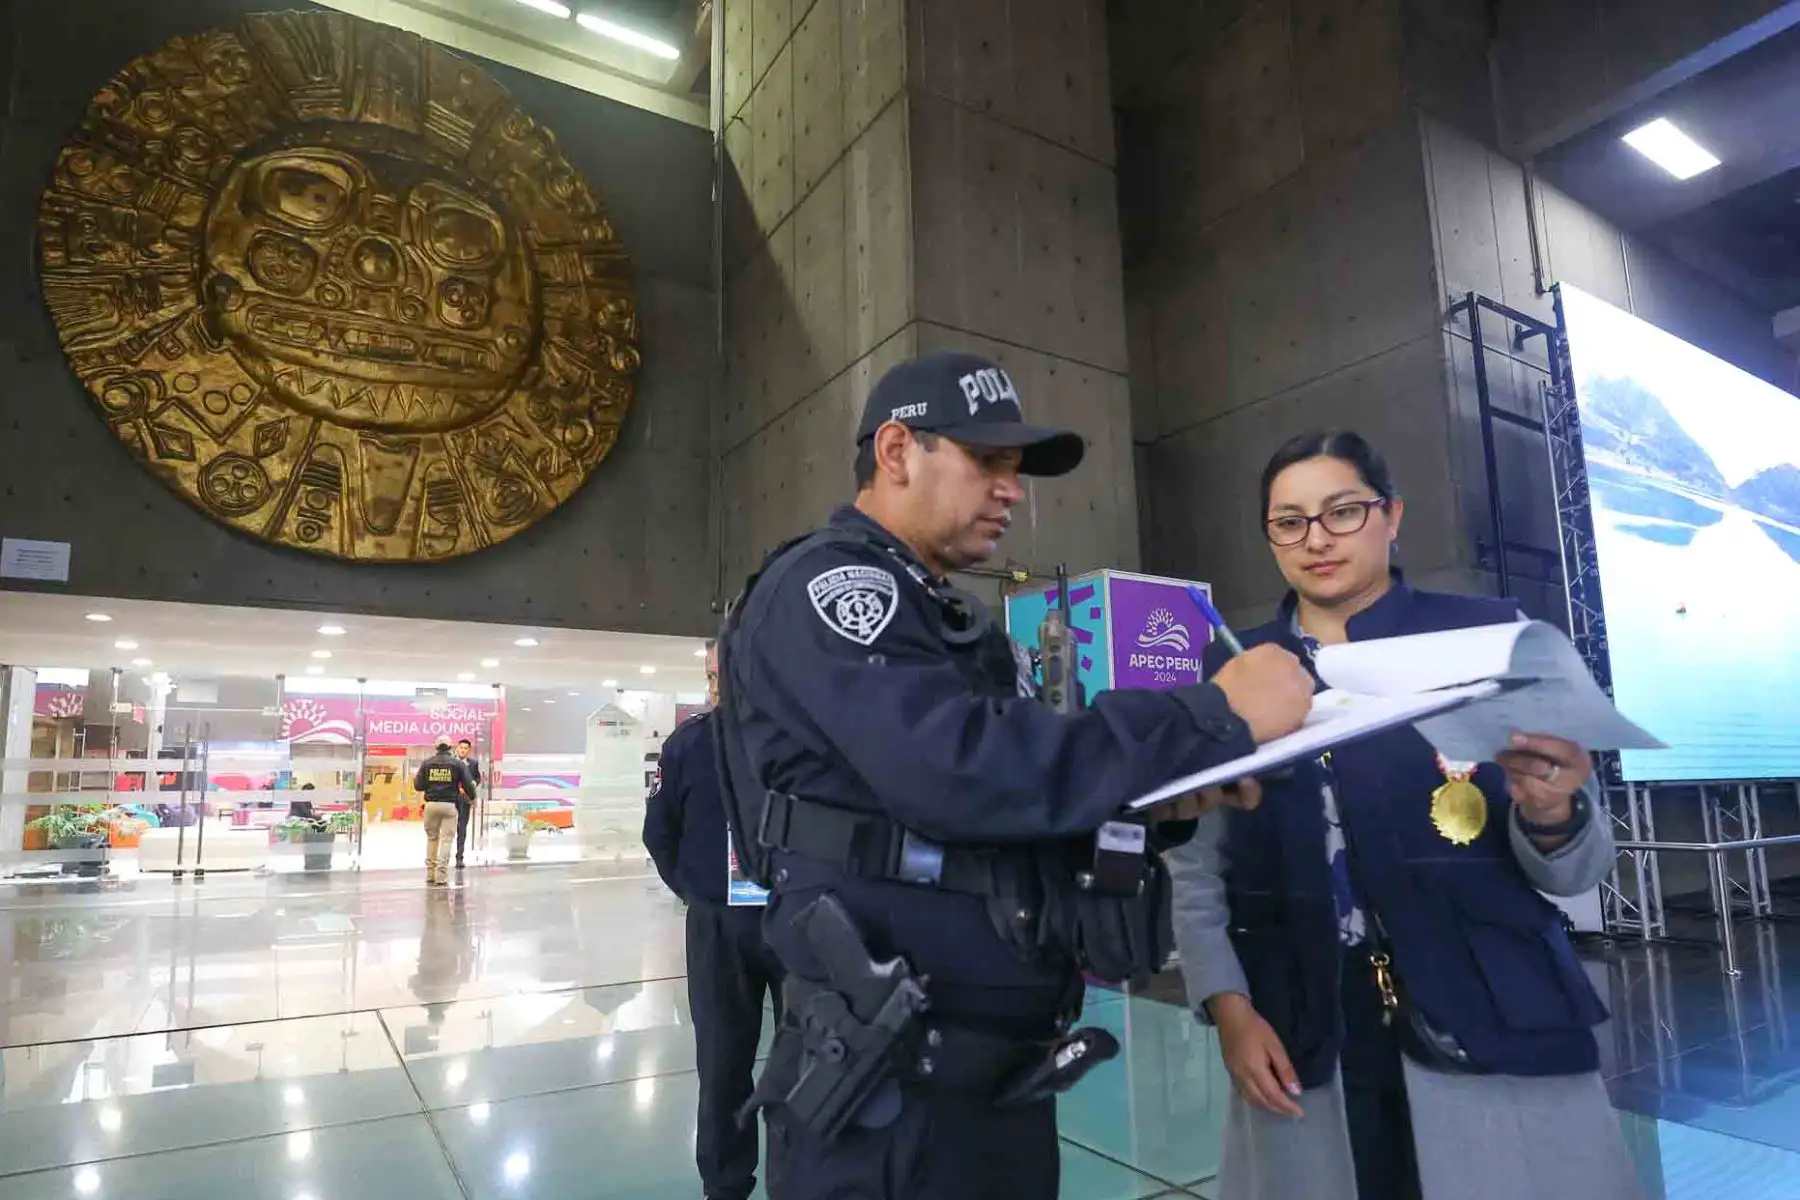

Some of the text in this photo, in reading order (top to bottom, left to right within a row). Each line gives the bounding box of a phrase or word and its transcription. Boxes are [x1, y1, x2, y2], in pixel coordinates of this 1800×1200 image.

[891, 402, 928, 421] PERU
[1129, 653, 1199, 672] APEC PERU
[1154, 671, 1177, 682] 2024
[429, 707, 485, 721] SOCIAL
[368, 719, 419, 734] MEDIA
